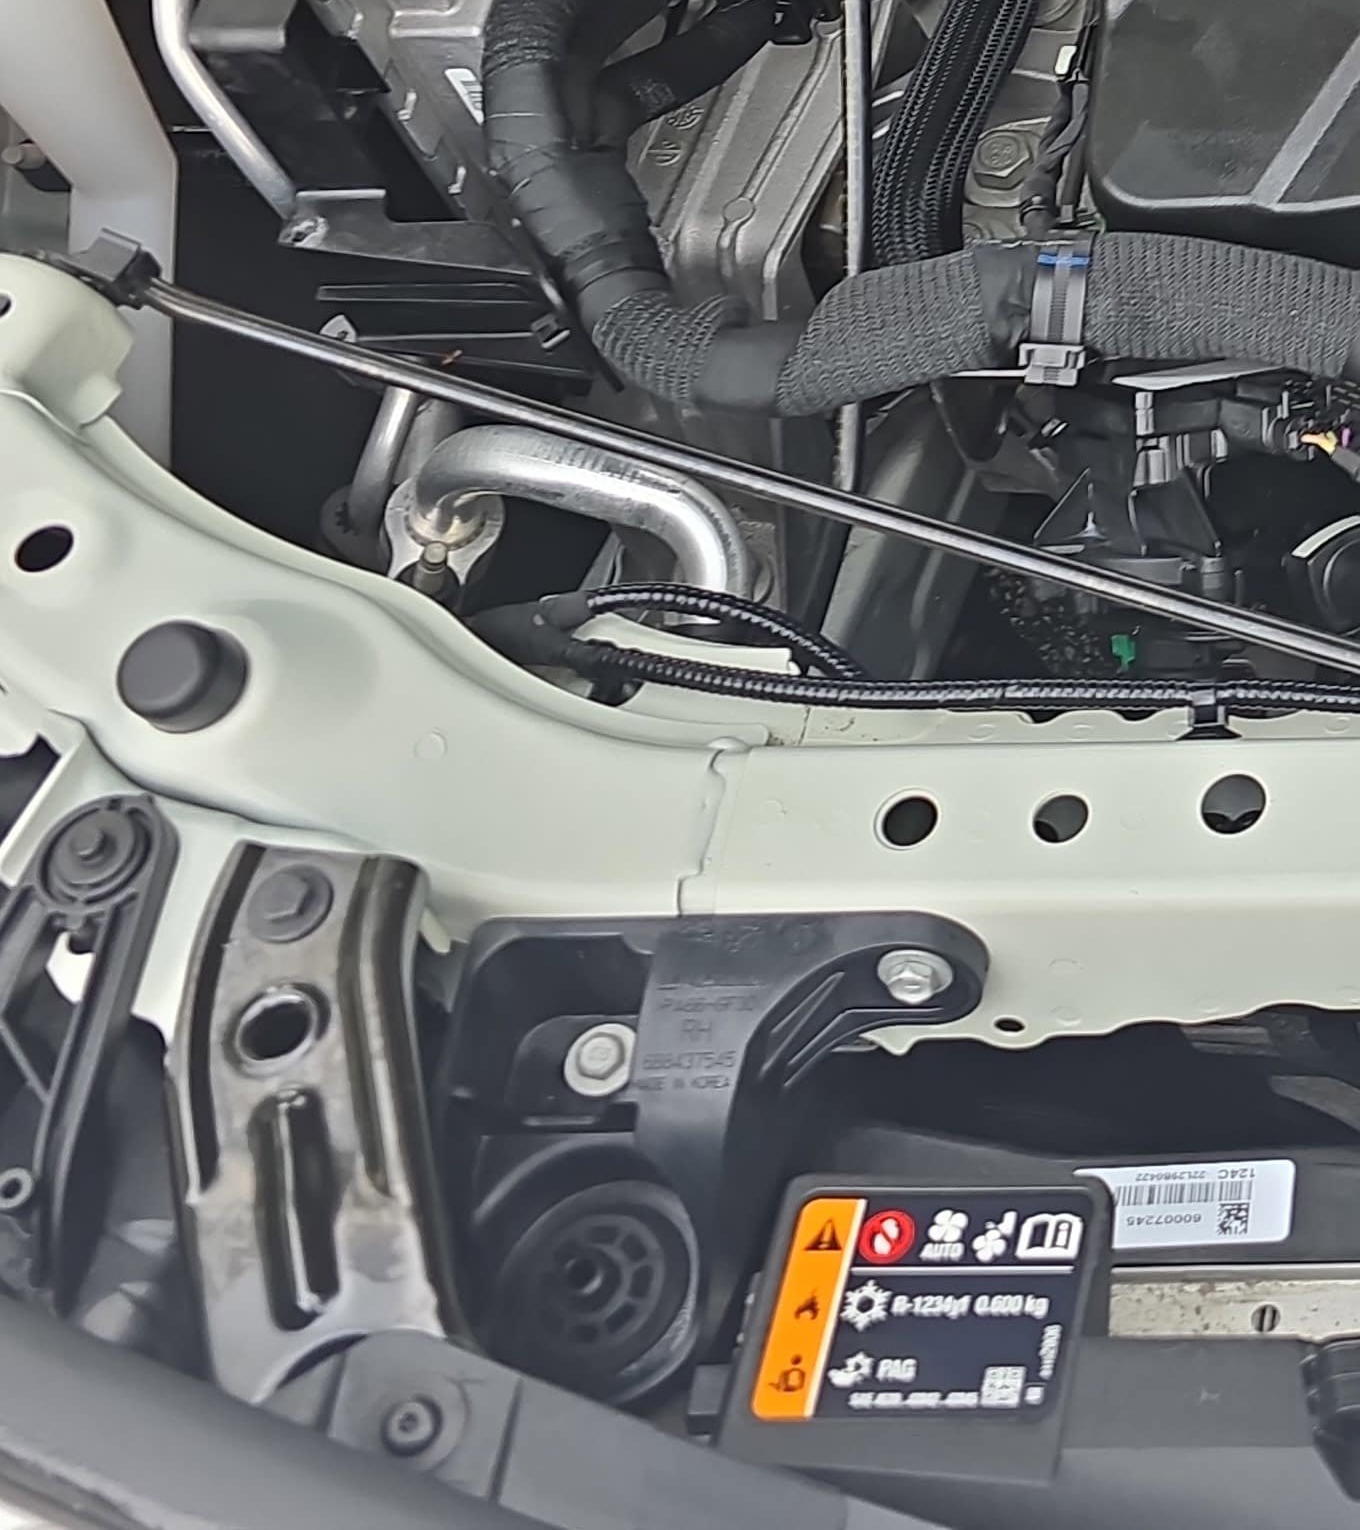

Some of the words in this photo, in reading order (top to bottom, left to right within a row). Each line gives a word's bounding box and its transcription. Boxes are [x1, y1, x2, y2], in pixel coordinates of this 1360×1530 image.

[1217, 1167, 1256, 1180] 124C
[1126, 1213, 1202, 1227] 60007245
[919, 1243, 966, 1261] AUTO
[974, 1295, 1022, 1314] 0.600
[1024, 1294, 1050, 1319] kg
[875, 1358, 918, 1382] PAG
